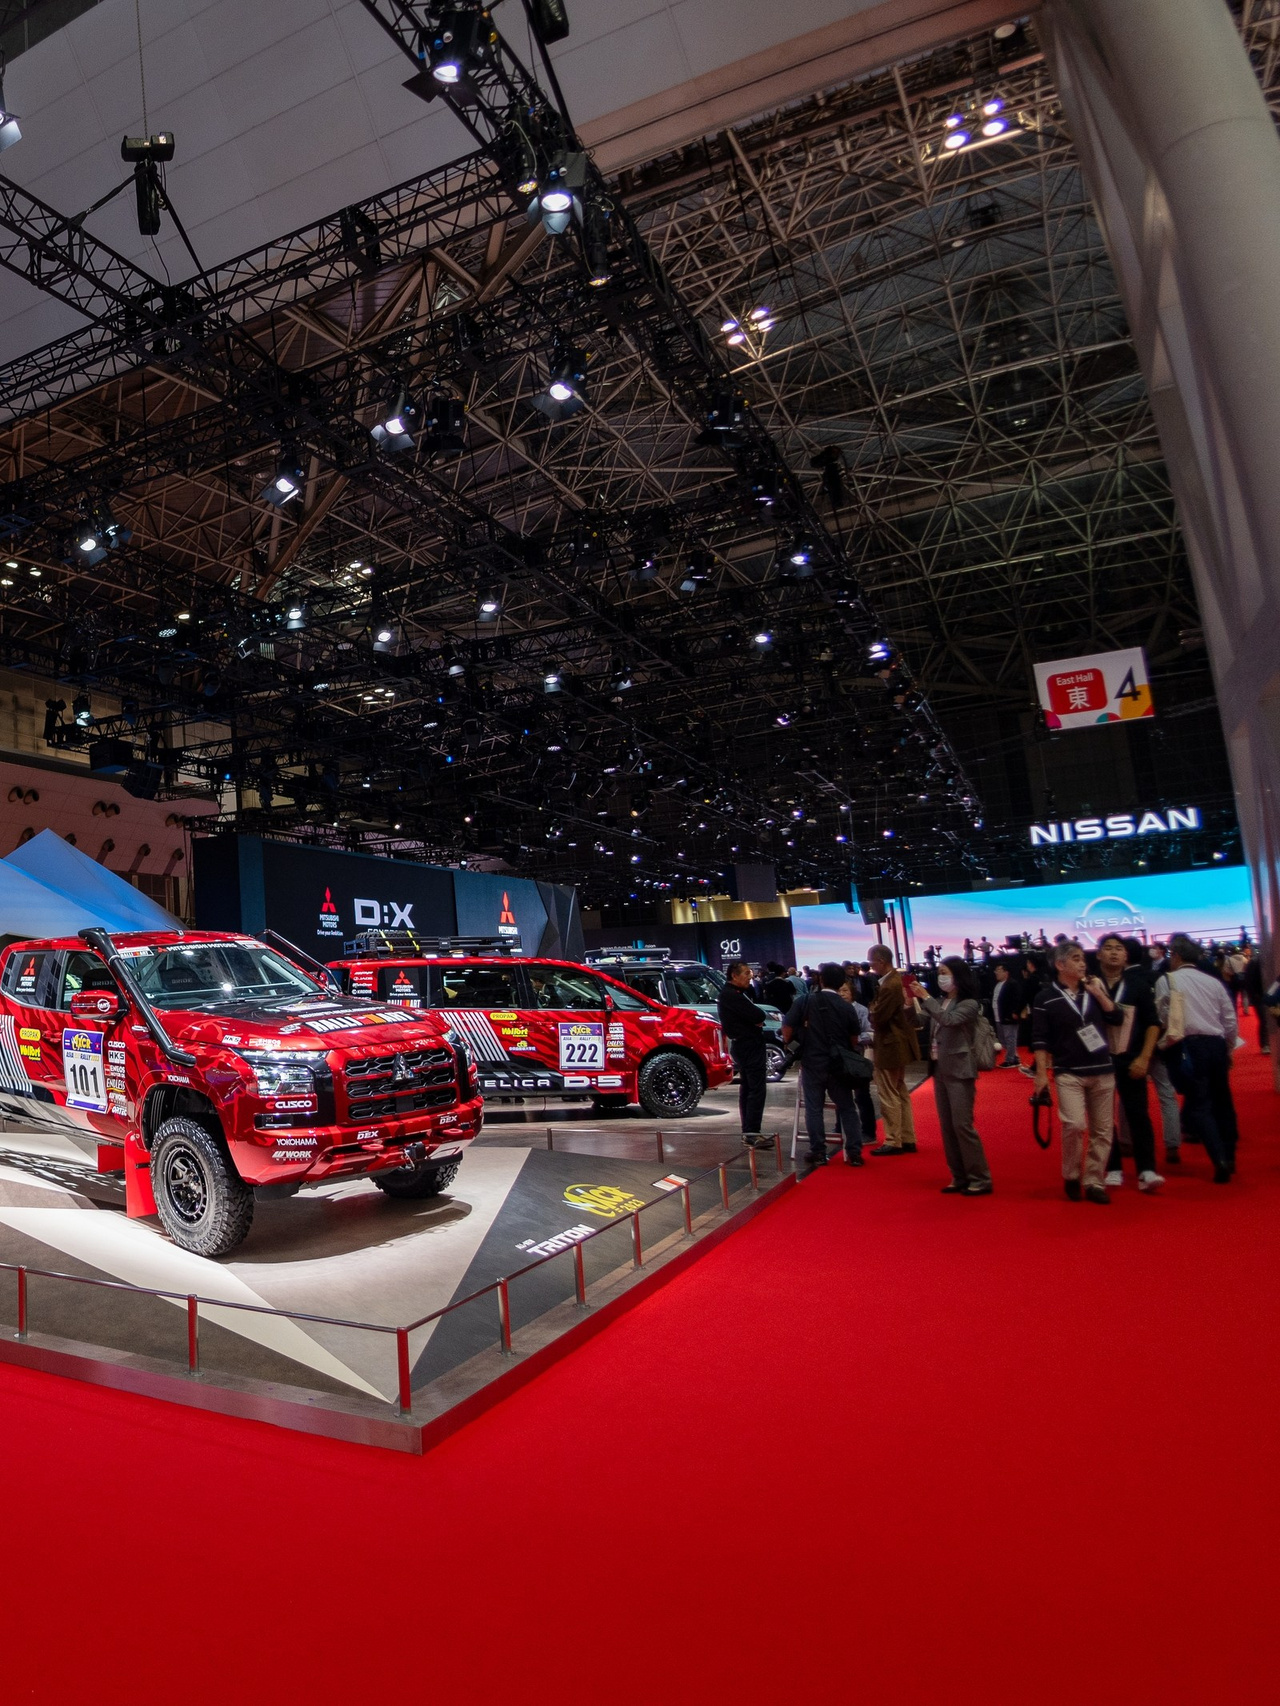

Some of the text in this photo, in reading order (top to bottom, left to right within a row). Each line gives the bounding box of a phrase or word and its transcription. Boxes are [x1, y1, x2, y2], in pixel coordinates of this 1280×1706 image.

[1056, 672, 1094, 686] East Hall
[1114, 665, 1142, 701] 4
[1065, 686, 1091, 710] 東
[1029, 807, 1200, 846] NISSAN
[319, 913, 340, 922] MITSUBISHI
[1075, 915, 1145, 929] NISSAN
[322, 921, 338, 929] MOTORS
[166, 944, 208, 952] MITSUBISHI
[720, 938, 741, 954] 90
[109, 1051, 125, 1060] HKS
[565, 1043, 598, 1063] 222
[69, 1063, 101, 1099] 101
[167, 1075, 190, 1084] YOKOHAMA
[478, 1075, 622, 1088] ELICA D:5
[274, 1100, 313, 1109] CUSCO
[439, 1115, 458, 1125] DEX
[357, 1130, 379, 1140] DEX
[276, 1138, 318, 1146] YOKOHAMA
[286, 1150, 313, 1159] WORK
[526, 1223, 597, 1257] TRITON
